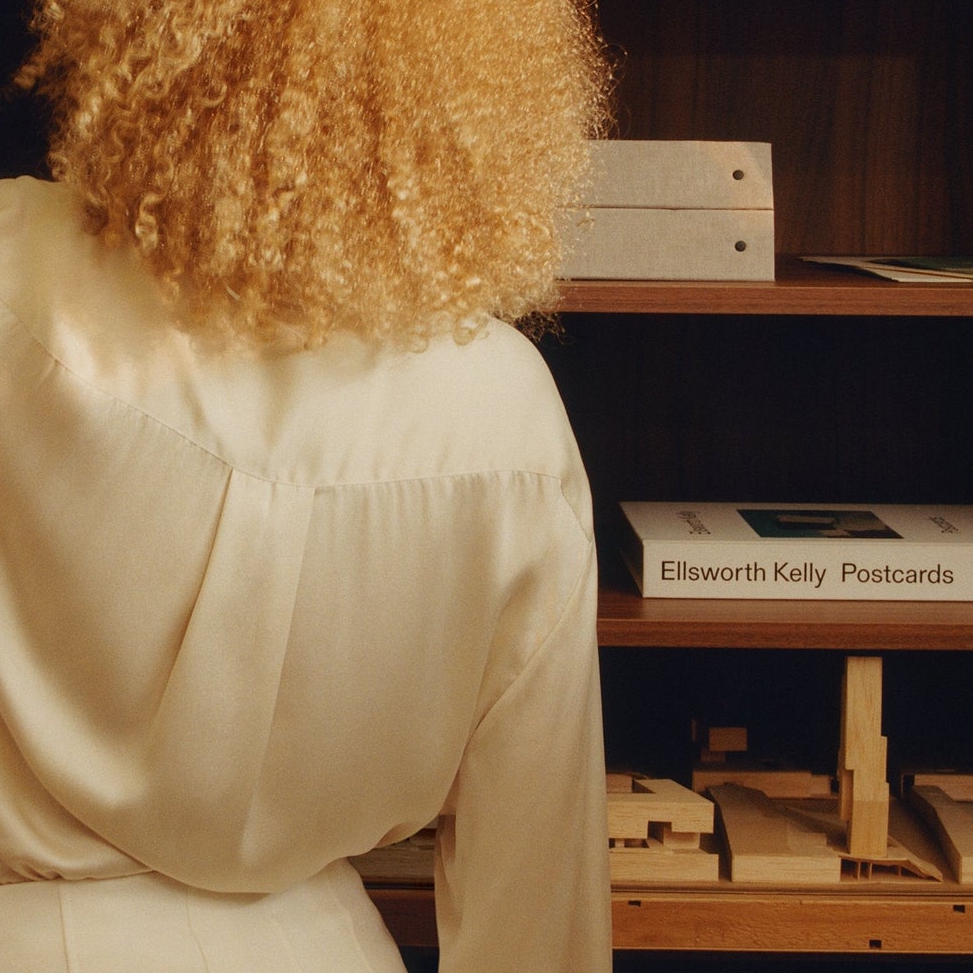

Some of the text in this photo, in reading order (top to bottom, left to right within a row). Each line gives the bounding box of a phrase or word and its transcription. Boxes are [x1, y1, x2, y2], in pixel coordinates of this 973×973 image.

[661, 560, 955, 589] Ellsworth Kelly Postcards
